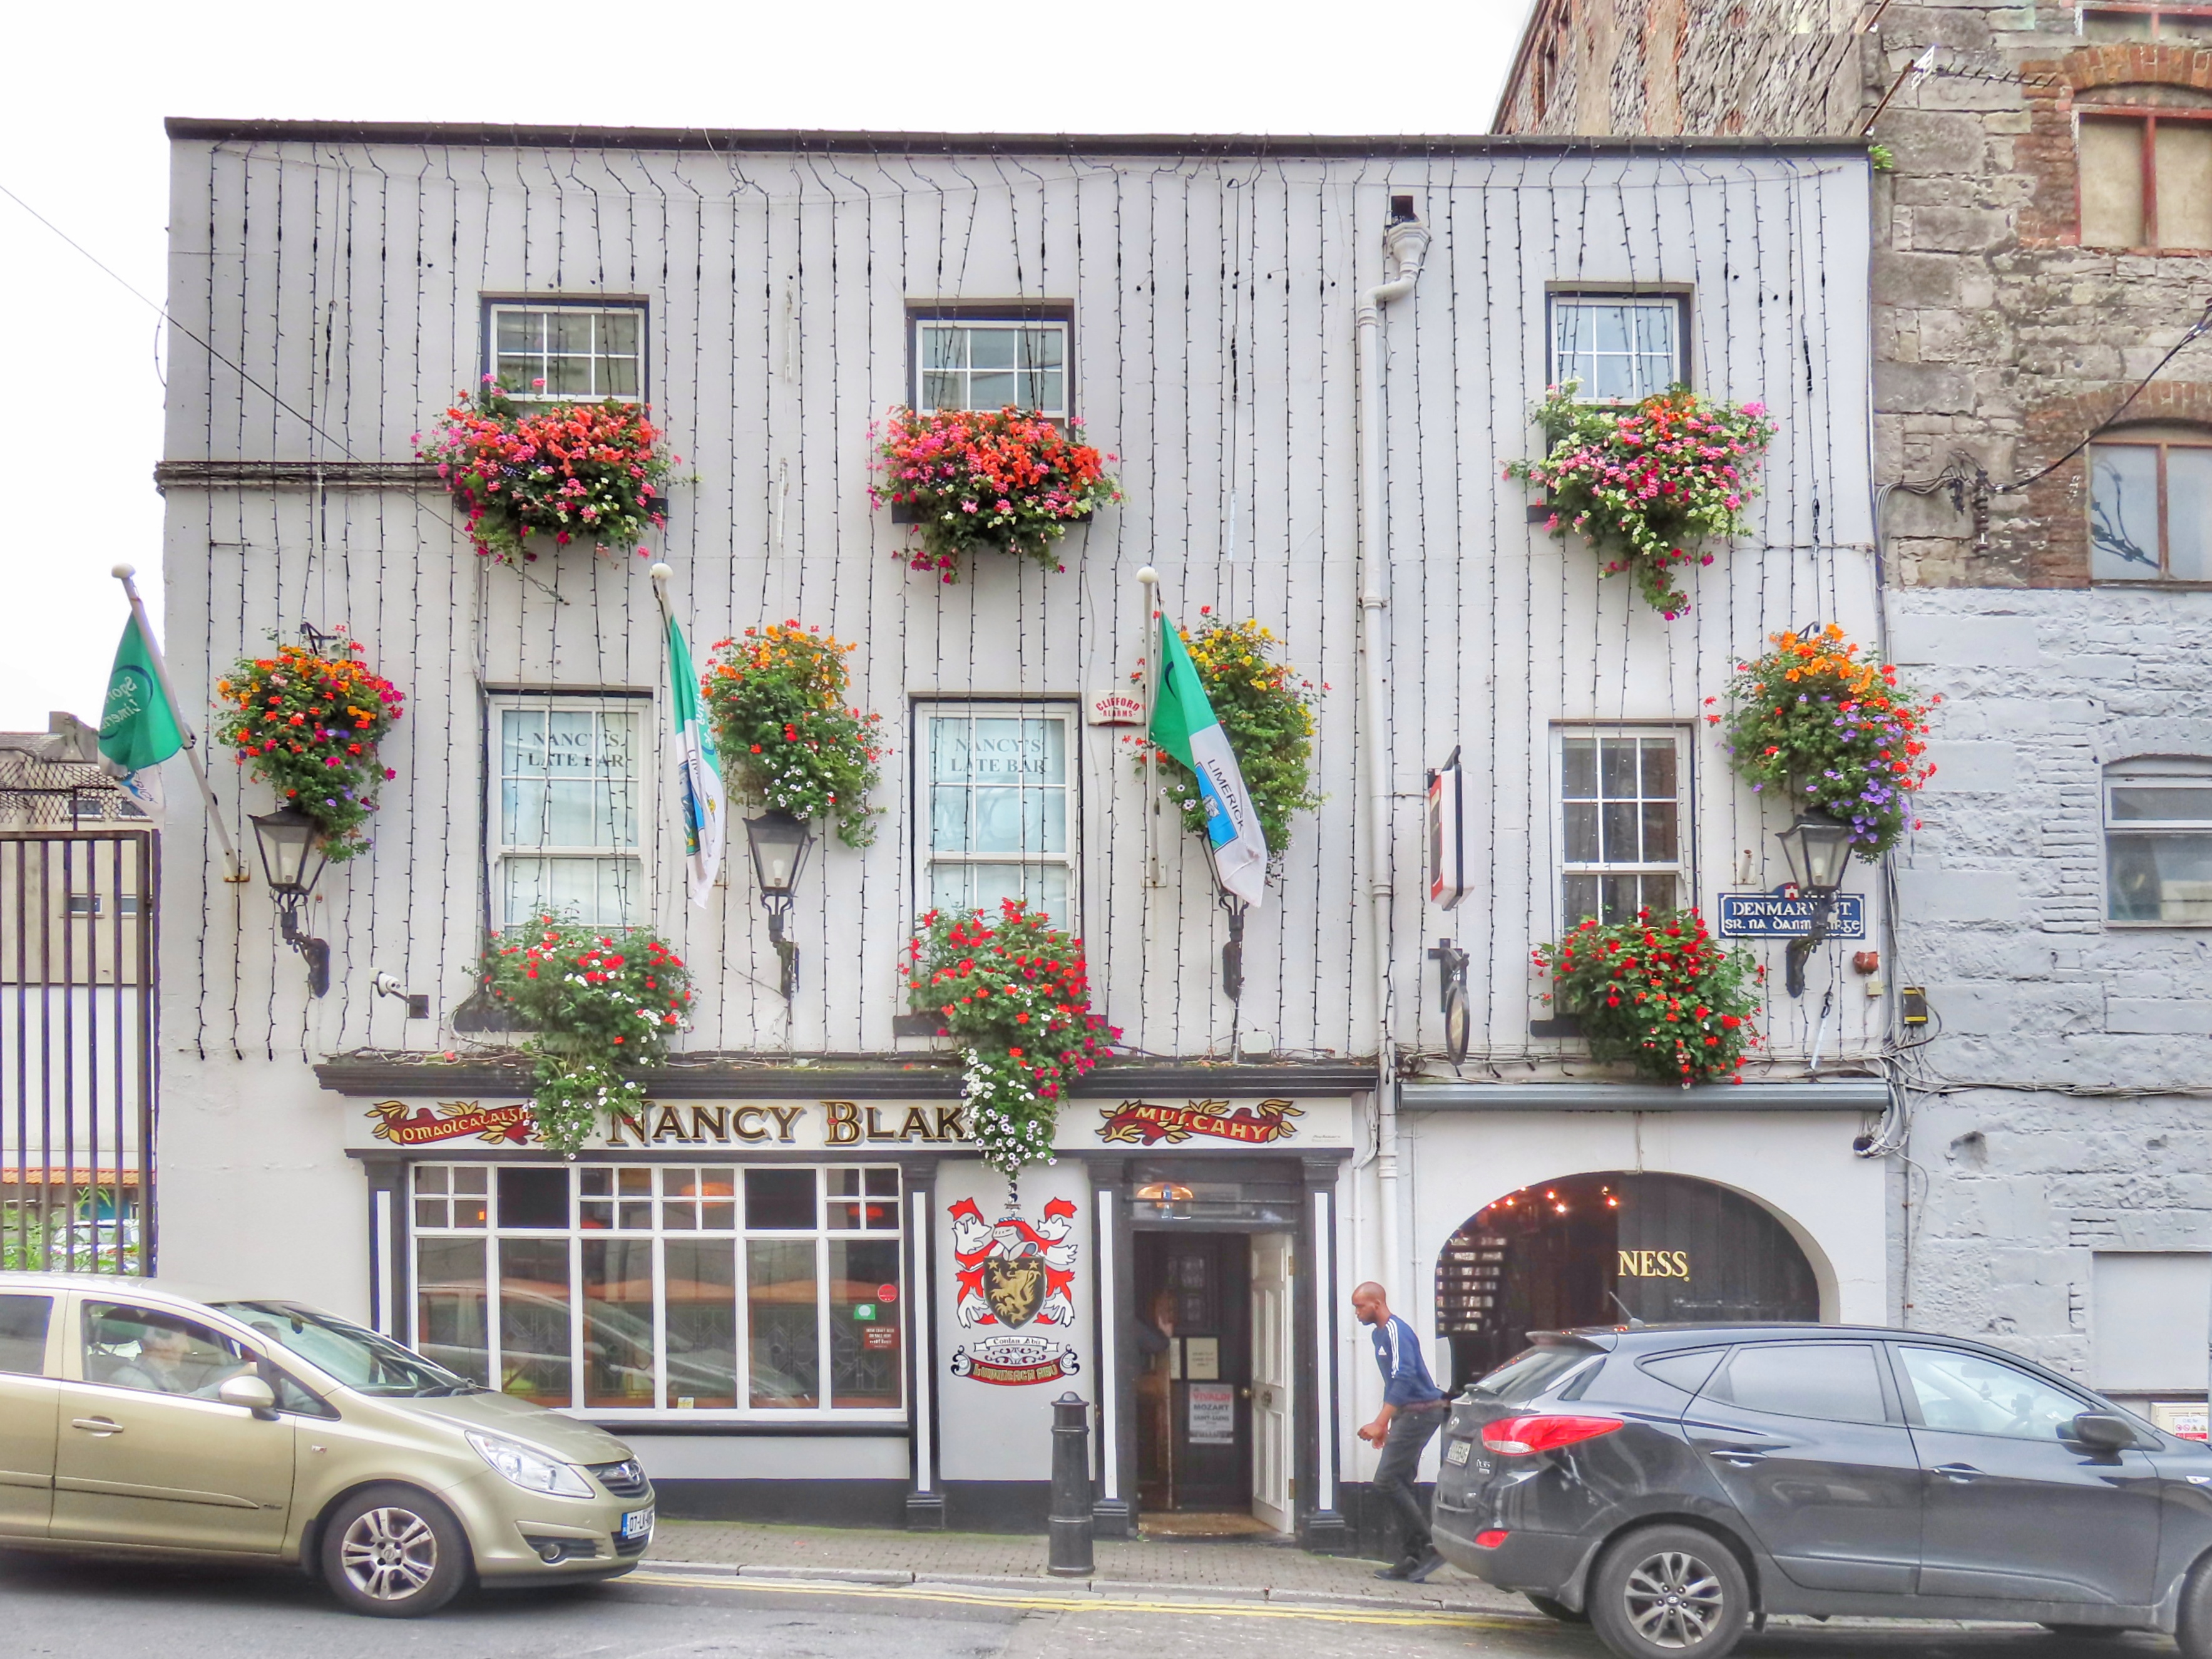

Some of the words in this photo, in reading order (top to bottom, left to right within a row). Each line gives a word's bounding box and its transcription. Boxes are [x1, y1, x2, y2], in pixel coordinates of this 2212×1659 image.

[1095, 697, 1140, 712] CLIFFORD
[533, 732, 620, 747] NANCS
[955, 738, 1042, 752] NANCY'S
[950, 758, 1001, 772] LATE
[1006, 759, 1045, 773] BAR
[1207, 759, 1244, 832] LIMERICK
[605, 1100, 806, 1147] NANCY
[820, 1100, 1057, 1147] BLAK
[1135, 1106, 1269, 1140] MULCAHY
[1617, 1250, 1689, 1278] NESS
[1193, 1392, 1231, 1401] VIVALDI
